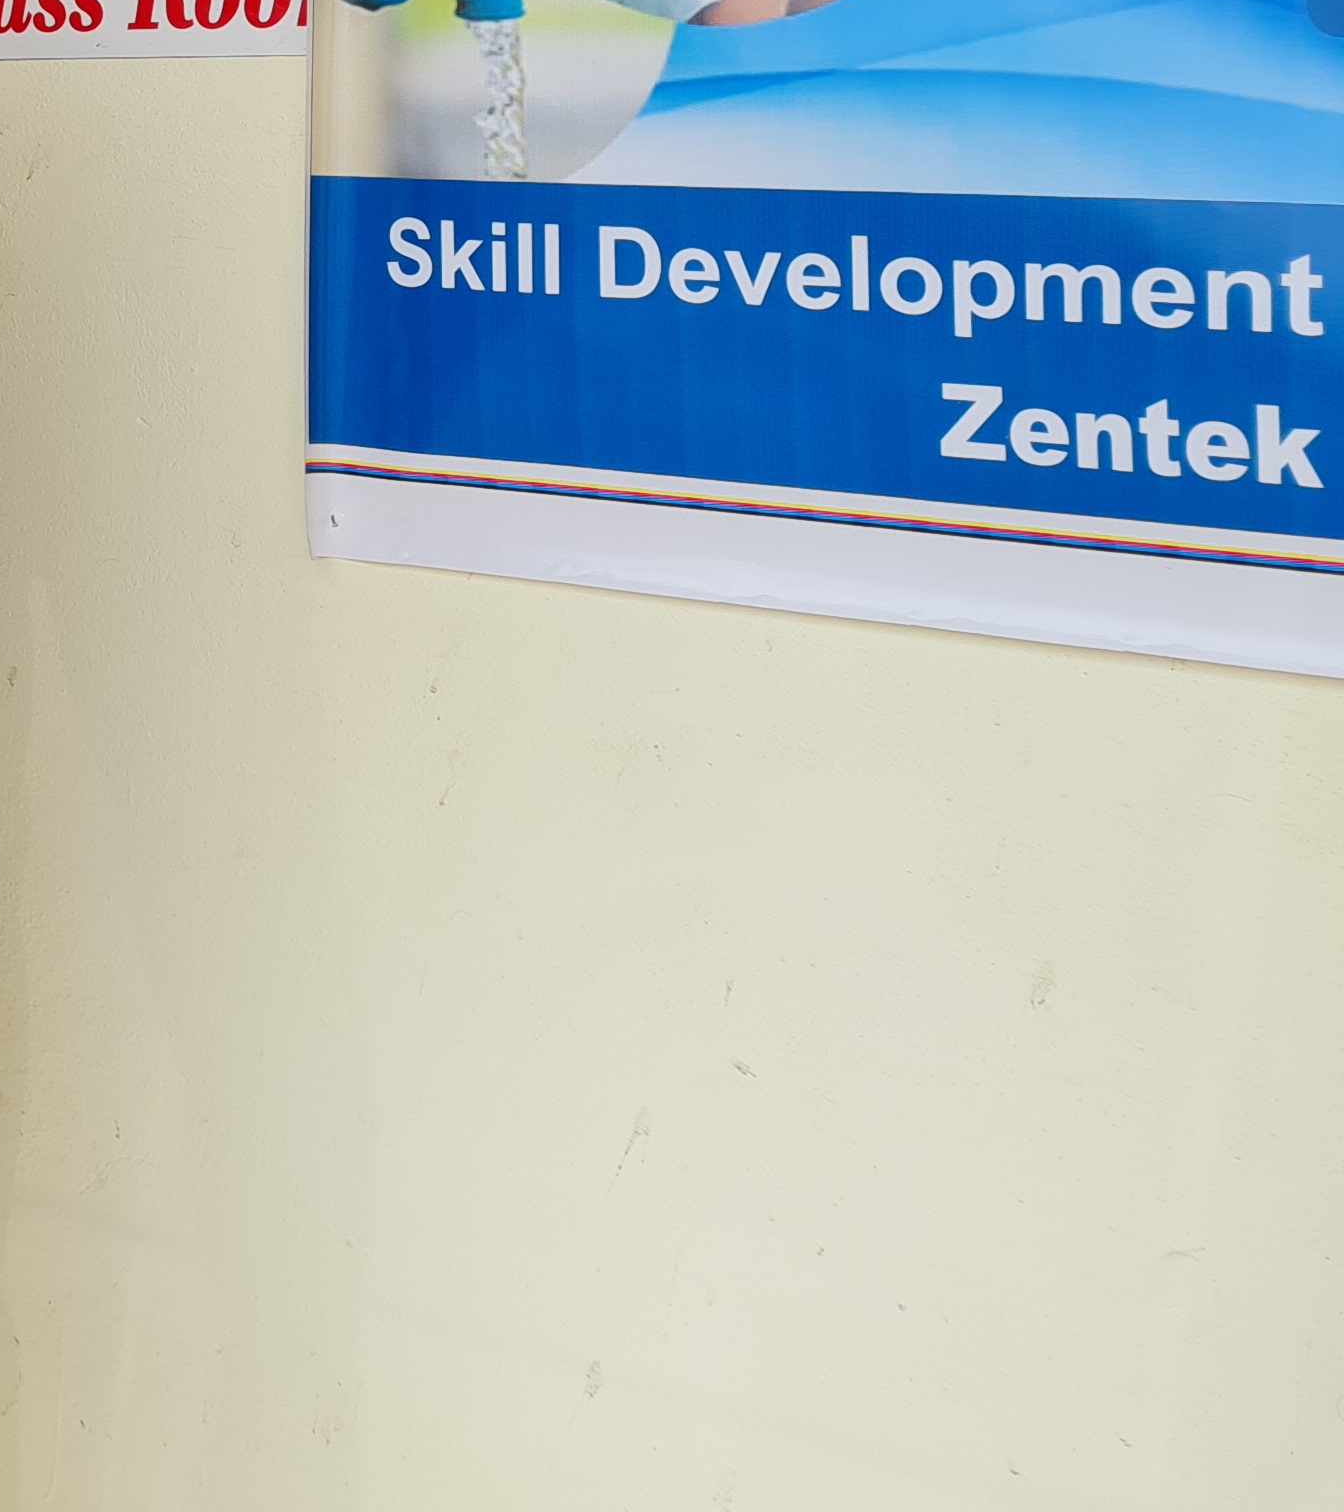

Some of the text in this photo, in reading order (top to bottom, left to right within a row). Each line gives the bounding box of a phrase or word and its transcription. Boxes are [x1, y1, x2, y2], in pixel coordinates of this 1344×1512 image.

[386, 217, 1325, 338] Skill Development
[939, 382, 1324, 489] Zentek
